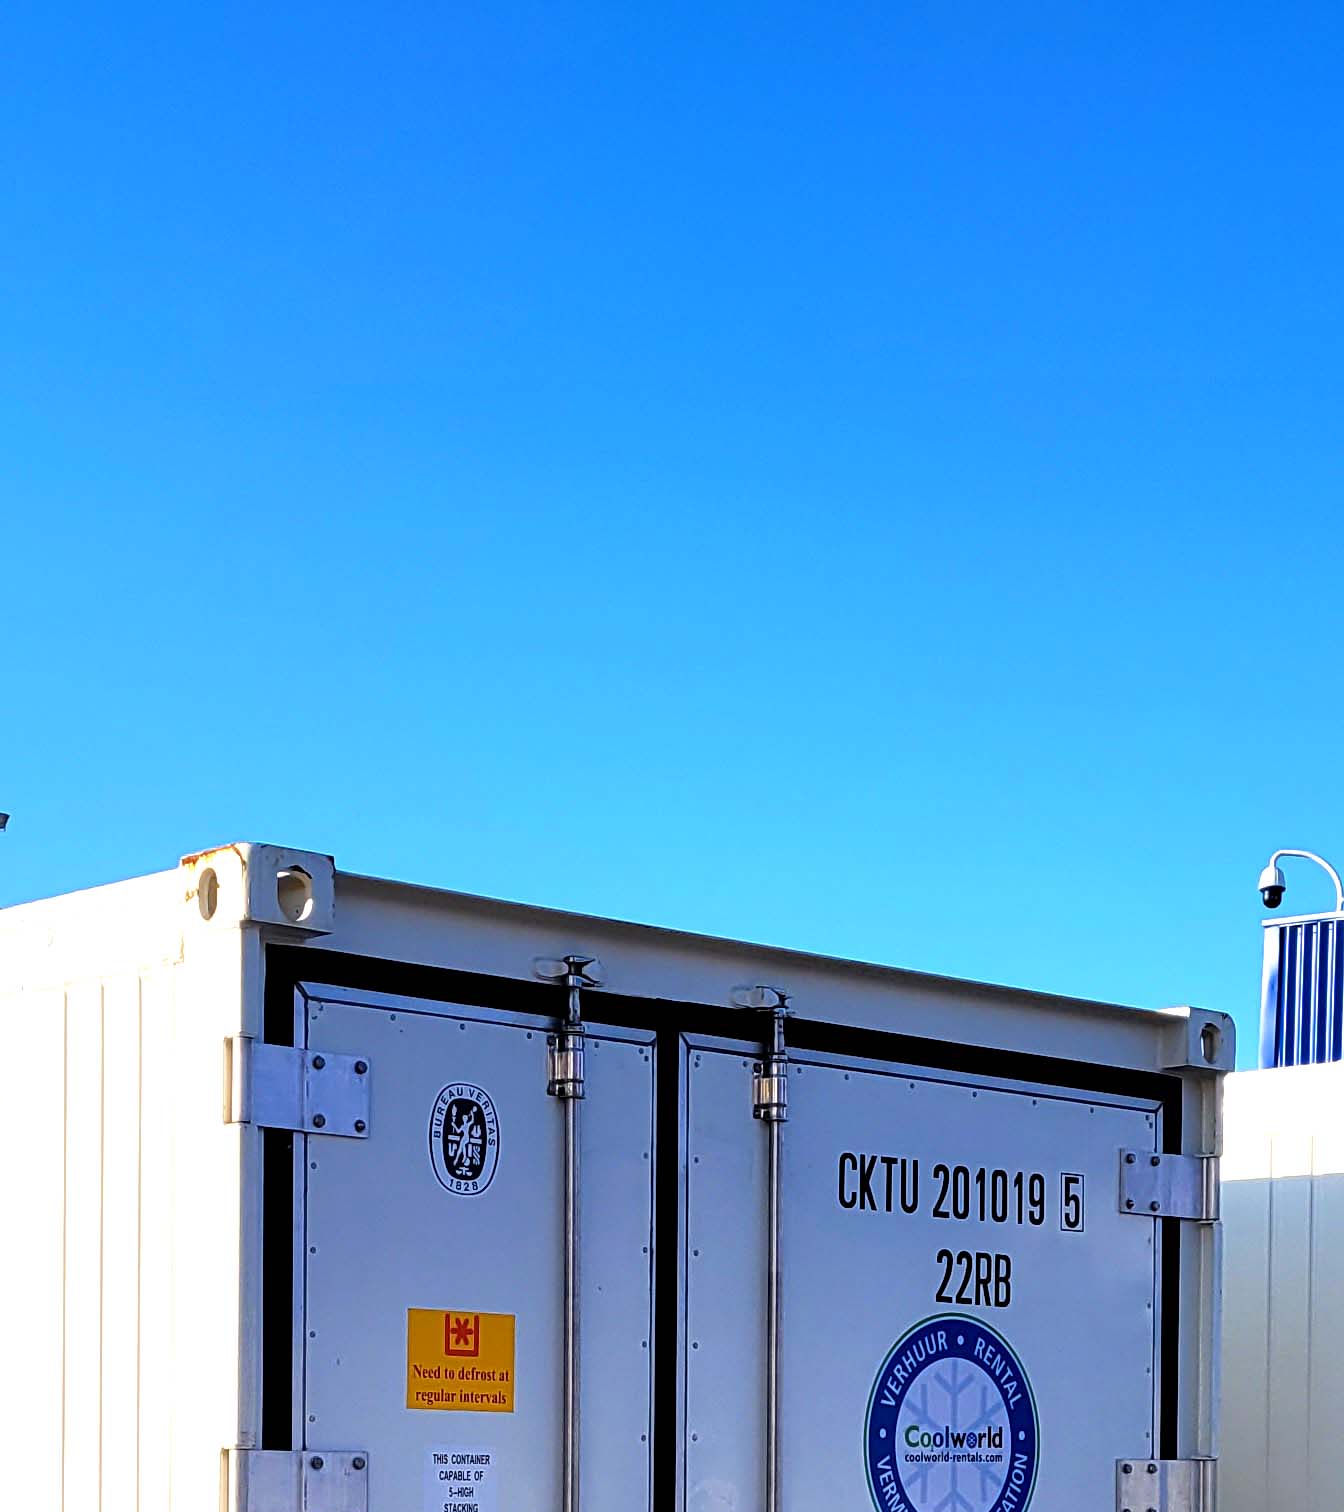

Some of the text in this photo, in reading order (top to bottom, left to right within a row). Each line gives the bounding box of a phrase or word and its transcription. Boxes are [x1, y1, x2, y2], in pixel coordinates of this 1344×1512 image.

[434, 1087, 496, 1147] BUREAU VERITAS
[449, 1179, 478, 1191] 1828
[838, 1152, 1082, 1230] CKTU 201019 5
[935, 1249, 1012, 1308] 22RB
[413, 1364, 509, 1381] Need to defrost at
[880, 1331, 1022, 1410] VERHUUR RENTAL
[416, 1390, 506, 1406] regular intervals
[904, 1424, 1003, 1449] Coolworld
[433, 1454, 490, 1465] THIS CONTAINER
[904, 1451, 1003, 1463] coolworld-rentals.com
[439, 1471, 484, 1481] CAPABLE OF
